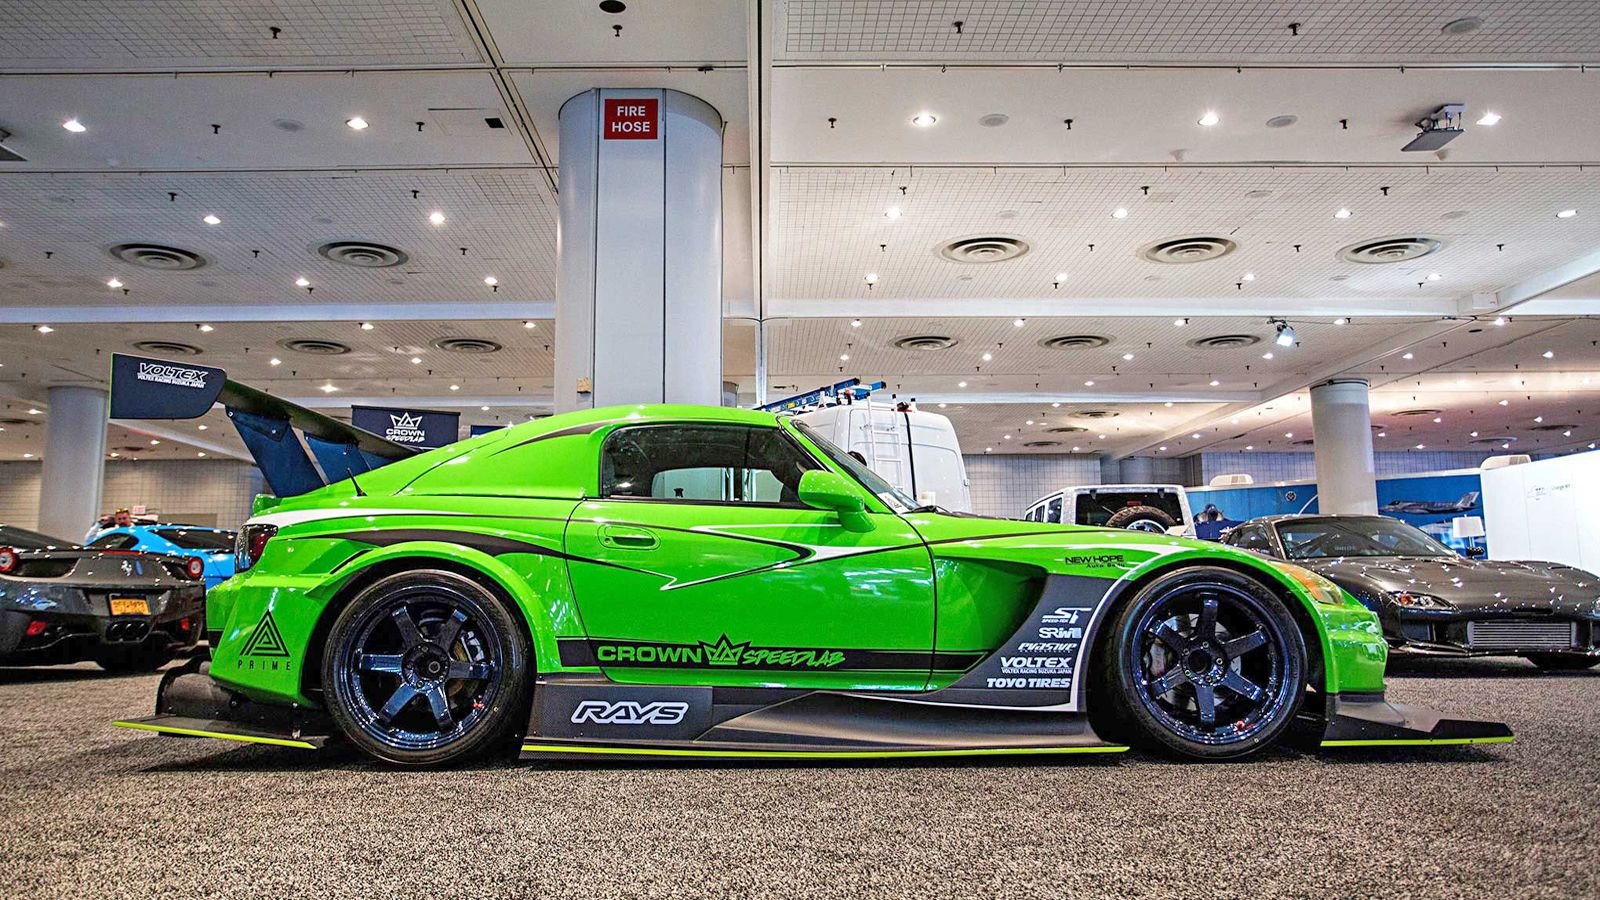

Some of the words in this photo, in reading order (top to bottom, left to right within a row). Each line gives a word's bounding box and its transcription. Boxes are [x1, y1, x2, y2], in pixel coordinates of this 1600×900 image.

[617, 106, 646, 117] FIRE
[612, 121, 650, 133] HOSE
[140, 362, 208, 382] VOLTEX
[386, 428, 425, 436] CROWN
[1065, 556, 1091, 565] NEW
[1093, 554, 1124, 563] HOPE
[597, 645, 702, 664] CROWN
[742, 649, 846, 668] SPEEDLAB
[1000, 656, 1072, 668] VOLTEX
[238, 659, 291, 671] PRIME
[986, 678, 1027, 688] TOYO
[1028, 678, 1071, 688] TIRES
[571, 700, 689, 725] RAYS
